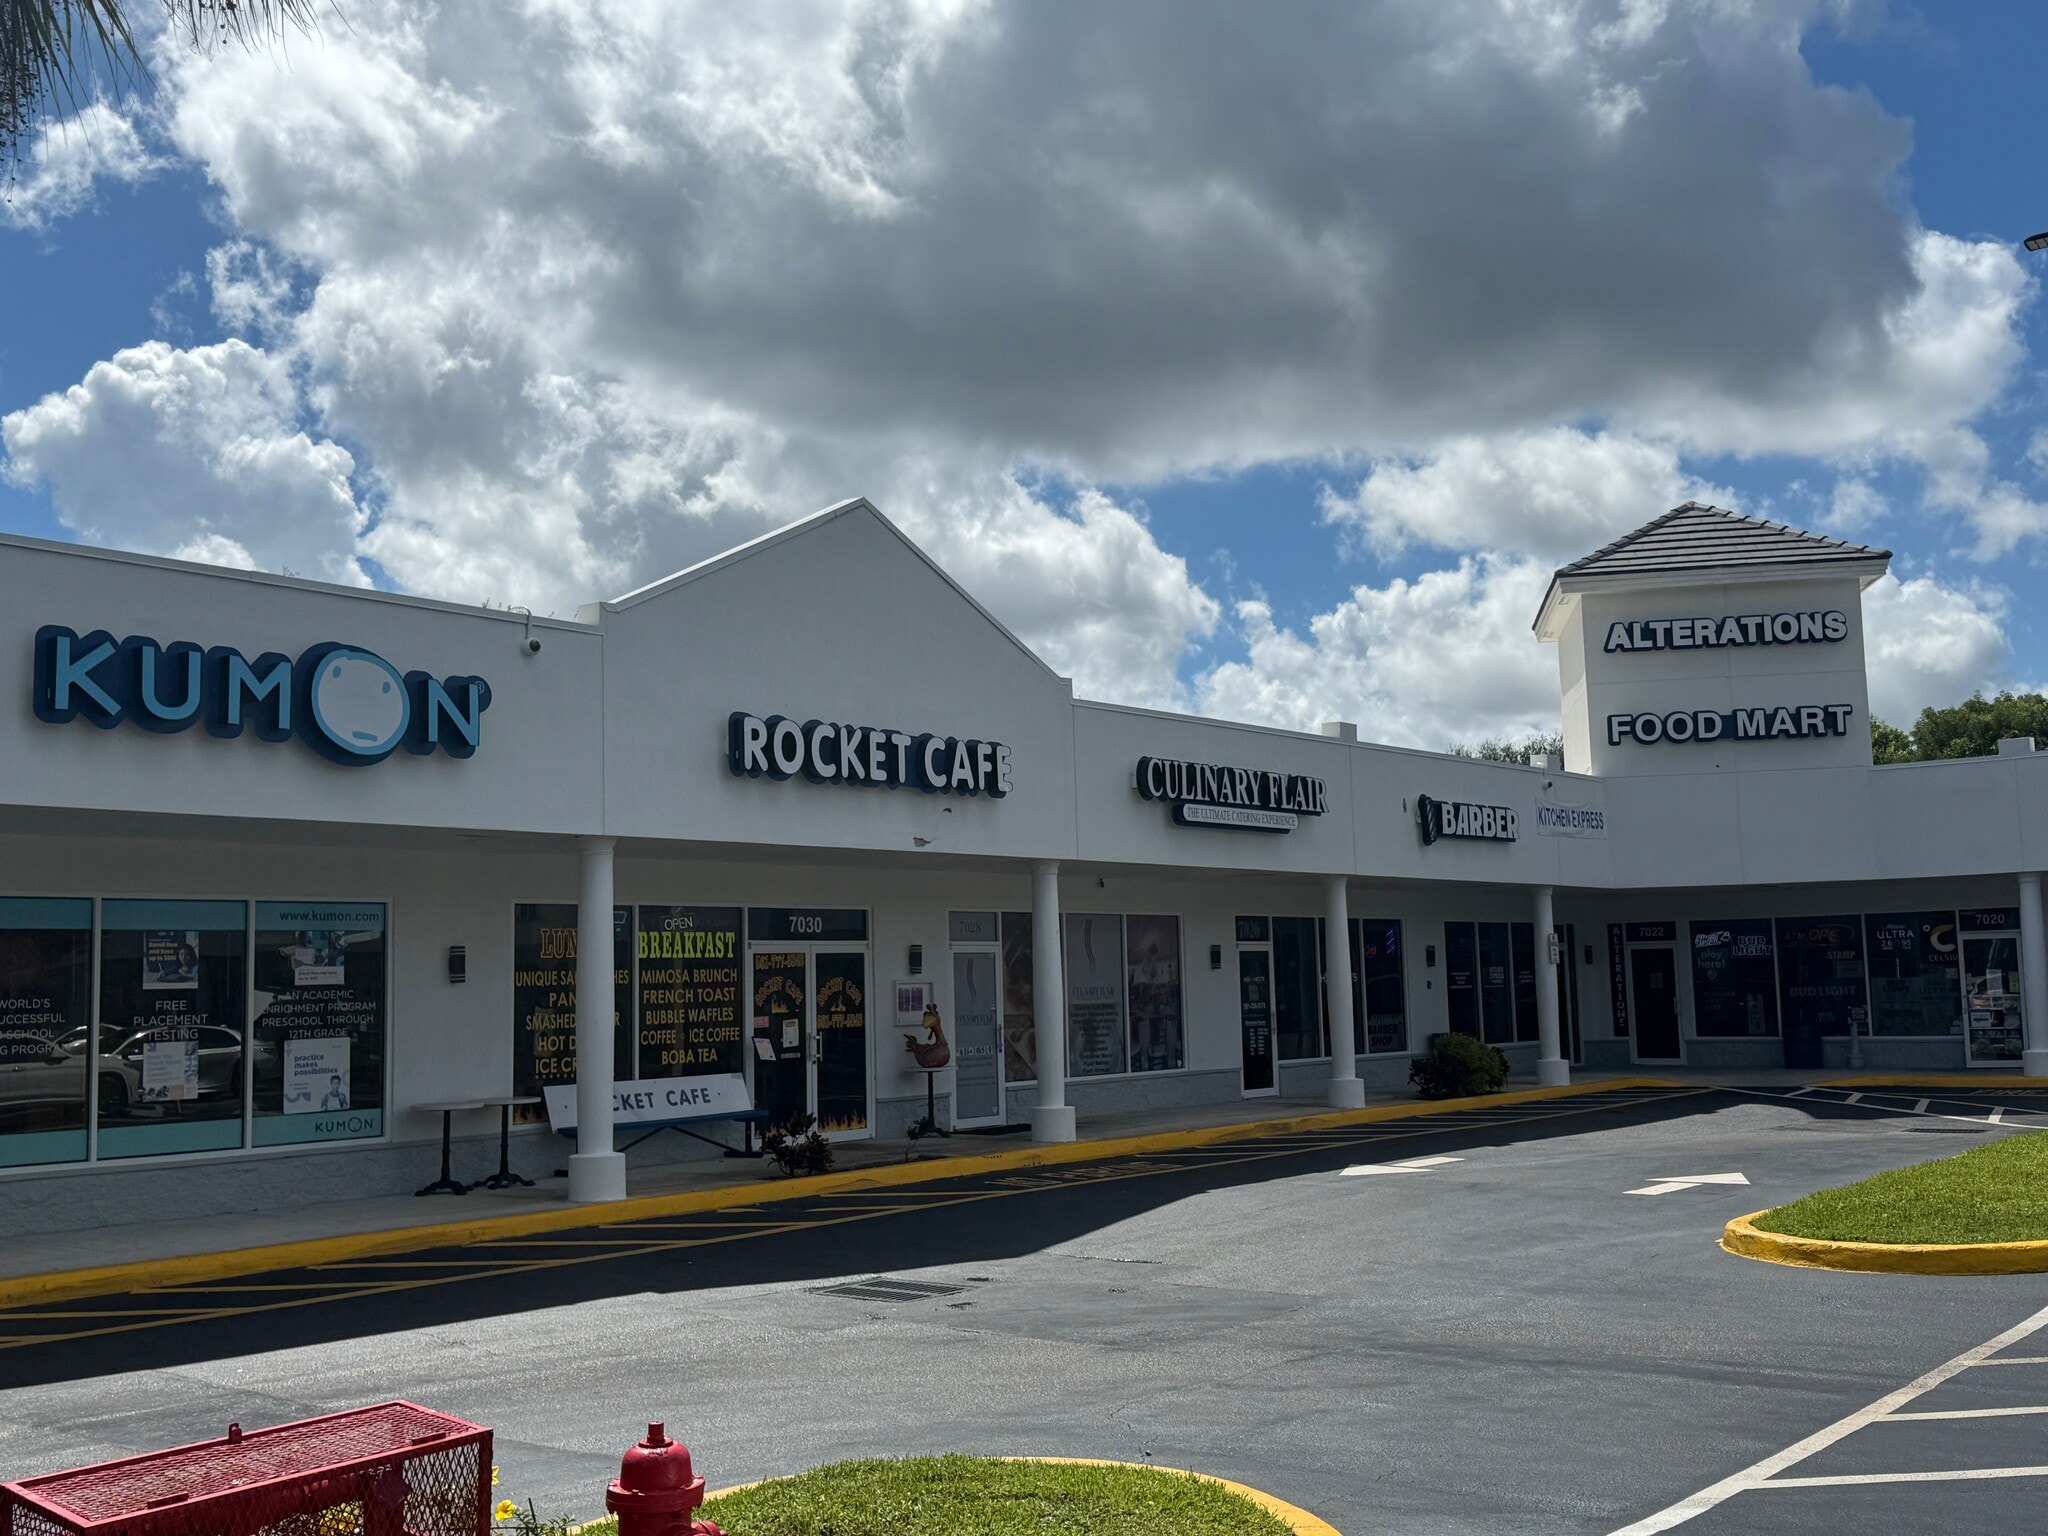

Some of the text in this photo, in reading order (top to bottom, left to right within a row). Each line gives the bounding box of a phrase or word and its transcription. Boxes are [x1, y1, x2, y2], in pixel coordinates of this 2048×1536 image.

[1607, 612, 1847, 650] ALTERATIONS
[54, 635, 480, 756] KUMON
[1611, 705, 1852, 743] FOOD MART
[743, 716, 1013, 793] ROCKET CAFE
[1147, 758, 1329, 813] CULINARY FLAIR
[1187, 806, 1296, 827] THE ULTIMATE CATERING EXPERIENCE
[1441, 803, 1520, 839] BARBER
[1537, 806, 1604, 830] KITCHEN EXPRESS
[279, 910, 379, 921] www.kumon.com
[1976, 914, 2005, 925] 7020
[664, 917, 693, 930] OPEN
[789, 916, 822, 933] 7030
[960, 921, 981, 934] 7028
[1639, 926, 1665, 937] 7022
[1877, 930, 1915, 939] ULTRA
[541, 928, 577, 958] LUN
[639, 931, 735, 959] BREAKFAST
[1738, 936, 1766, 946] BUD
[1701, 949, 1721, 960] play
[1733, 946, 1772, 956] LIGHT
[1827, 951, 1856, 960] STAMP
[1929, 953, 1957, 963] CELSIU
[515, 970, 557, 987] UNIQUE
[641, 968, 738, 984] MIMOSA BRUNCH
[1612, 926, 1626, 1028] ALTERATIONS
[302, 990, 354, 1000] ACADEMIC
[643, 987, 736, 1004] FRENCH TOAST
[1789, 985, 1856, 998] BUD LIGHT
[0, 998, 51, 1009] WORLD'S
[155, 1000, 187, 1011] FREE
[264, 1002, 376, 1014] NRICHMENT PROGRAM
[0, 1013, 66, 1025] UCCESSFUL
[133, 1014, 209, 1027] PLACEMENT
[262, 1014, 374, 1027] PRESCHOOL THROUGH
[526, 1013, 577, 1031] SMASHED
[646, 1007, 734, 1025] BUBBLE WAFFLES
[147, 1029, 199, 1041] TESTING
[289, 1028, 349, 1039] 12TH GRADE
[1367, 1023, 1399, 1036] BARBER
[641, 1027, 740, 1046] COFFEE ICE COFFEE
[1371, 1036, 1392, 1047] SHOP
[538, 1036, 565, 1052] HOT
[294, 1054, 324, 1063] practice
[661, 1047, 718, 1065] BOBA TEA
[294, 1067, 338, 1077] possibilities
[535, 1058, 558, 1074] ICE
[666, 1087, 712, 1107] CAFE
[315, 1117, 373, 1133] KUMON
